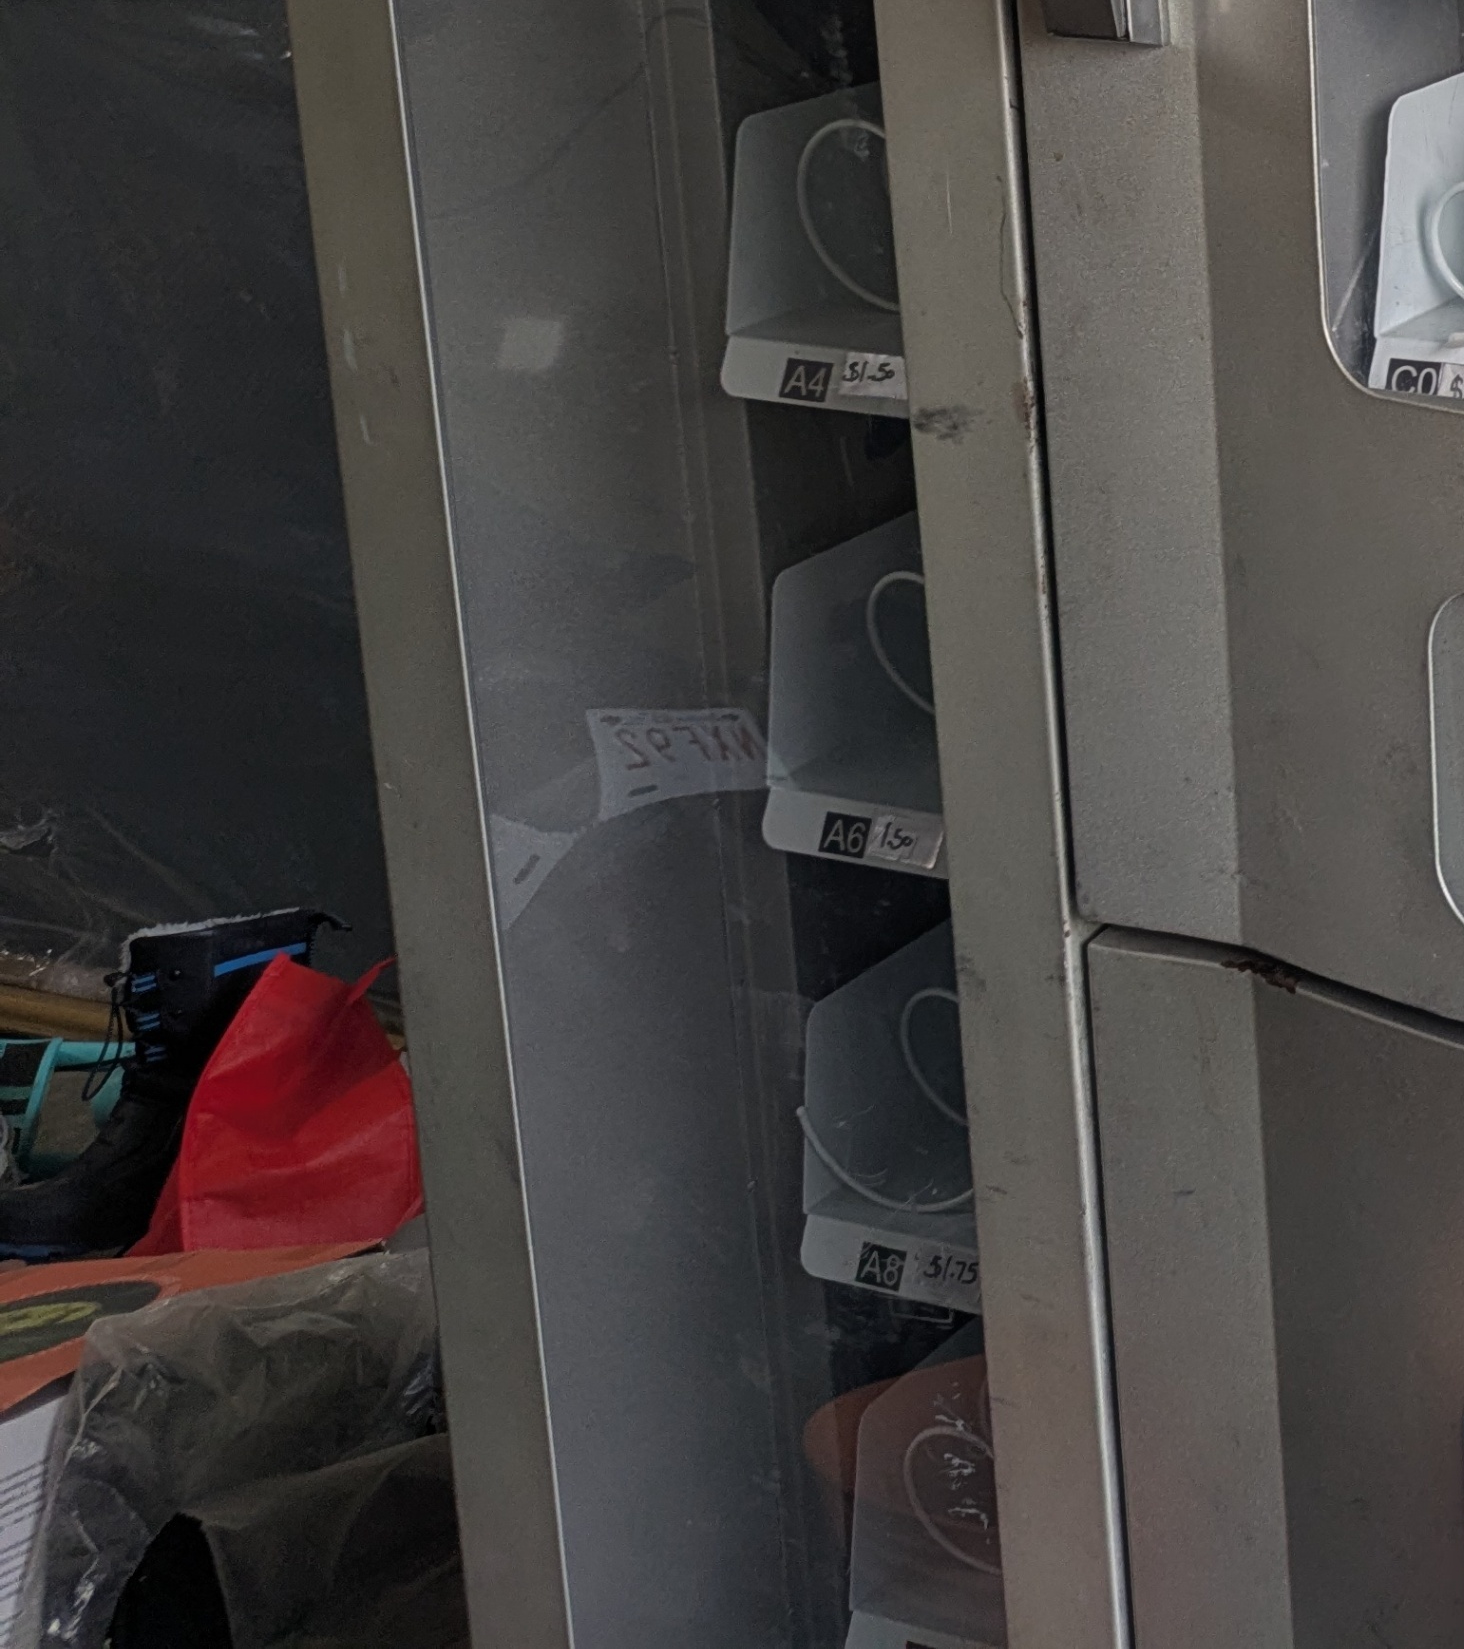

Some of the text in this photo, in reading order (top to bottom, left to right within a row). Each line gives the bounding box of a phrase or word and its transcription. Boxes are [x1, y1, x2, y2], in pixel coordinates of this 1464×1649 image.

[783, 364, 829, 398] A4
[1391, 365, 1439, 396] C0
[822, 818, 866, 854] A6
[859, 1250, 901, 1287] A8
